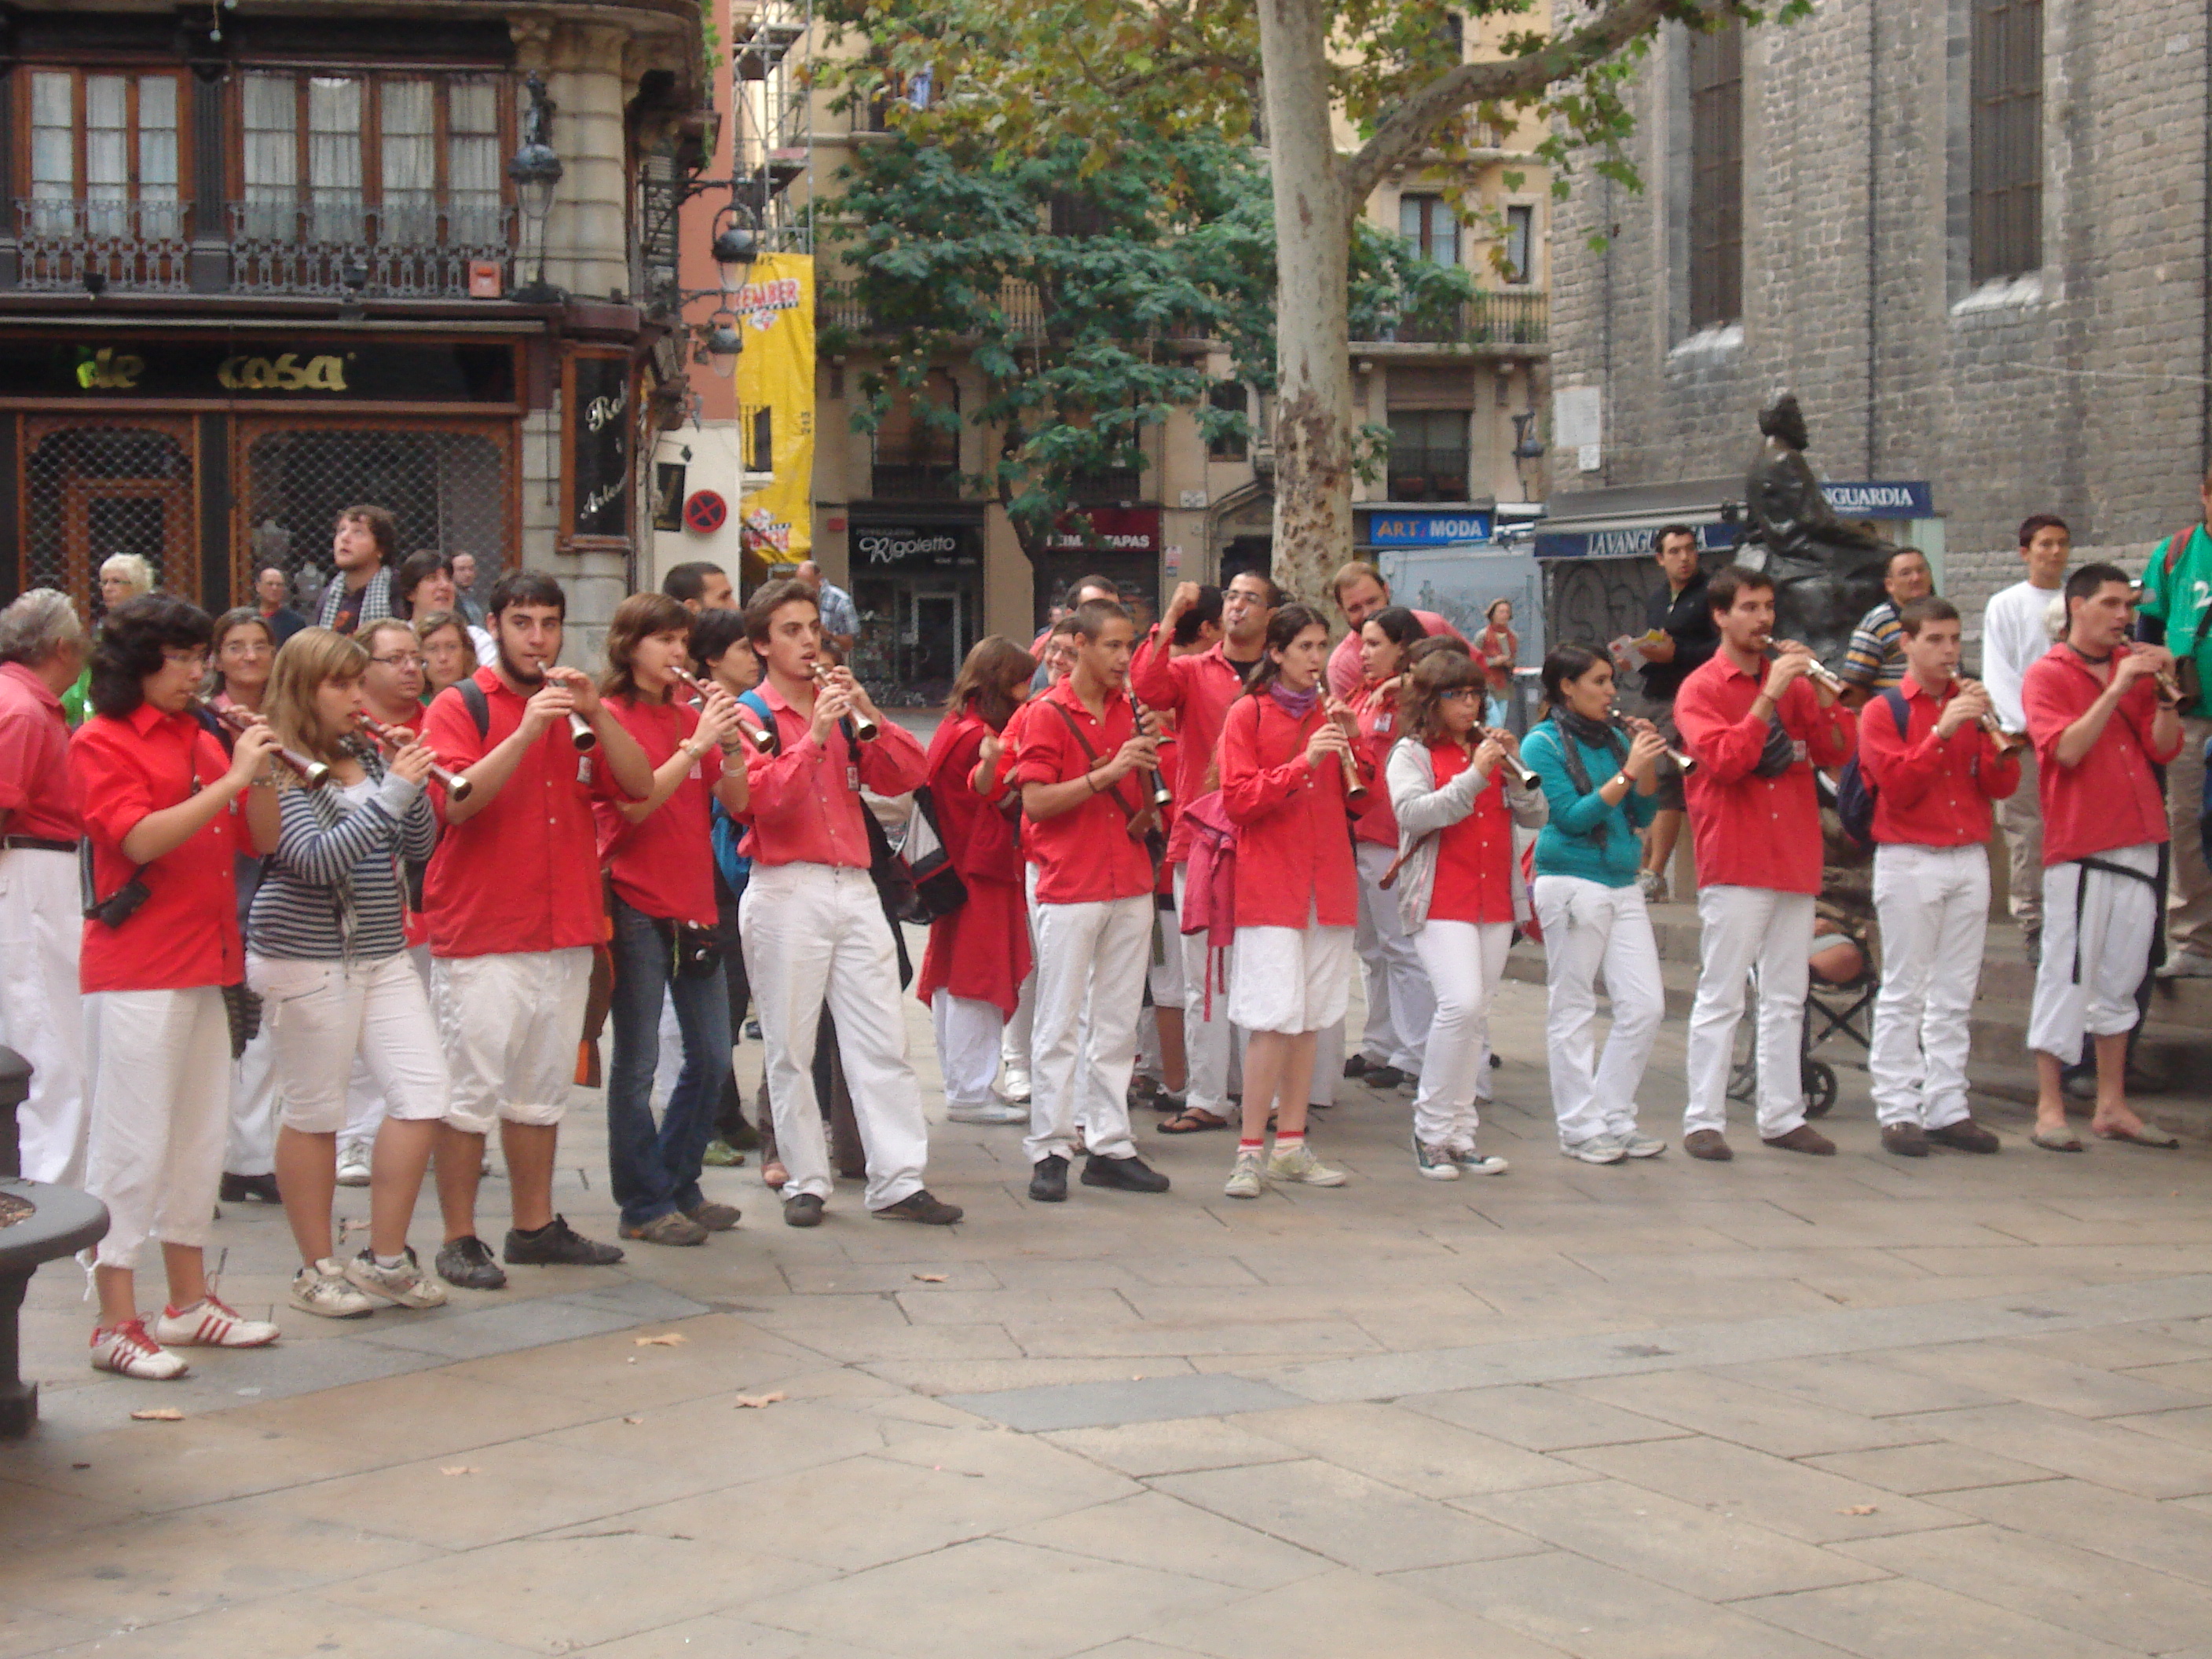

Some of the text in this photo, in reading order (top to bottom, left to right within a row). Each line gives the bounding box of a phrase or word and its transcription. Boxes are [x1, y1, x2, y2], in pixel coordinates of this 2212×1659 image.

[1377, 520, 1420, 537] ART
[1428, 519, 1484, 538] MODA
[859, 535, 956, 564] Rigoletto
[1103, 533, 1150, 550] TAPAS
